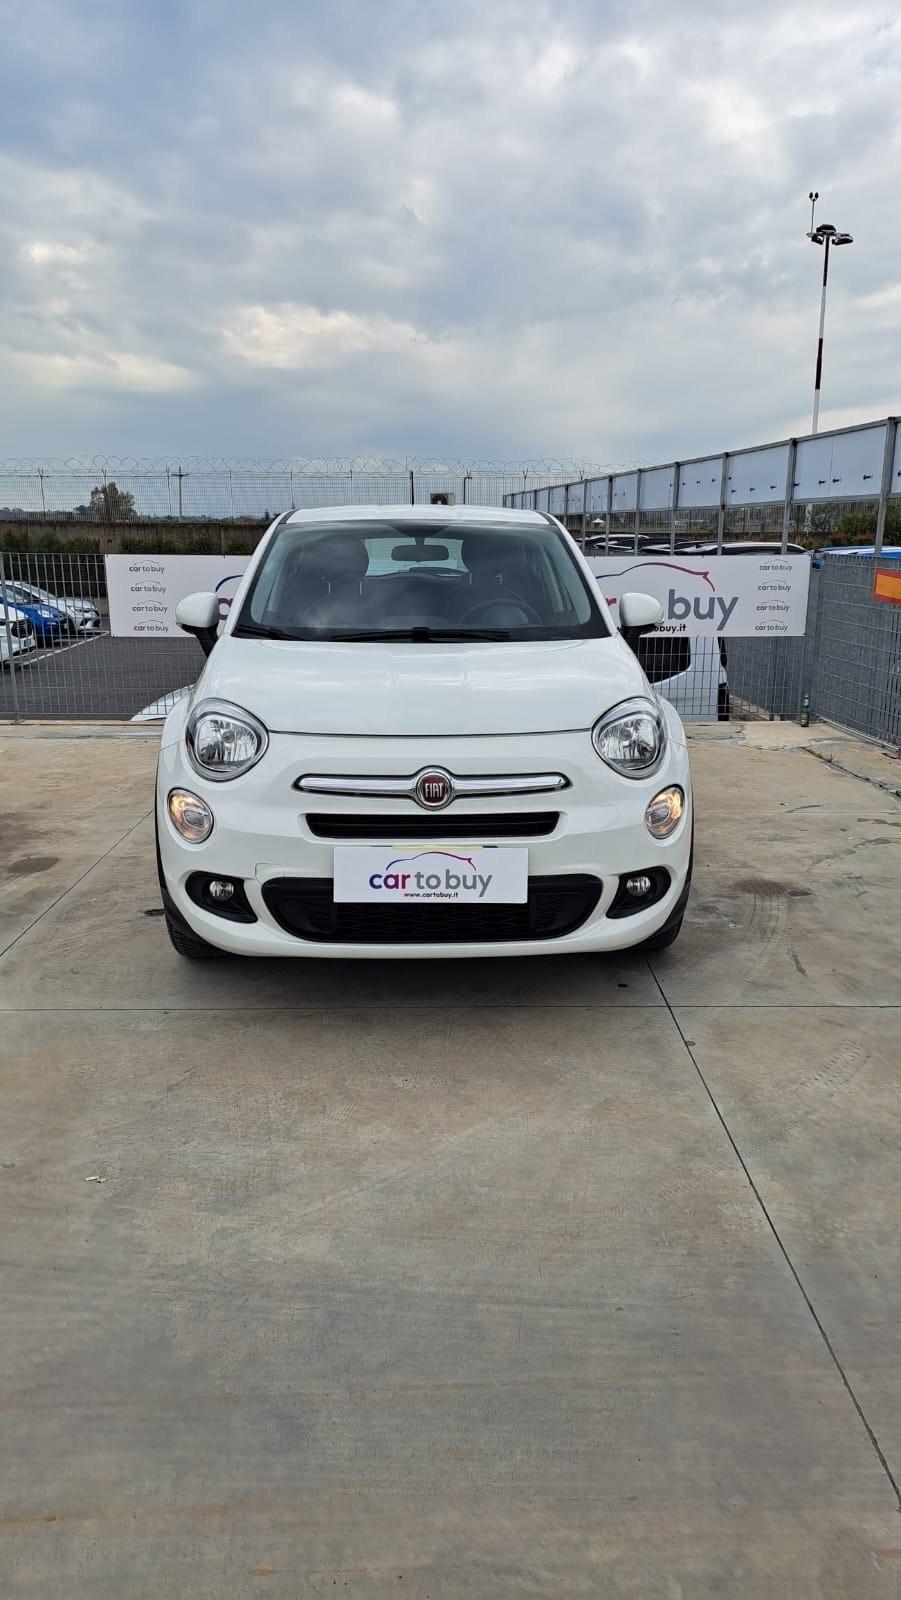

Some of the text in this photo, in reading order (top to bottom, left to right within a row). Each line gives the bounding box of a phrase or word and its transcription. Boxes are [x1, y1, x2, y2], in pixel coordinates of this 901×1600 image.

[142, 564, 150, 572] to
[151, 564, 165, 574] buy
[780, 564, 793, 572] buy
[144, 584, 152, 592] to
[152, 584, 166, 594] buy
[778, 584, 792, 592] buy
[145, 604, 153, 612] to
[154, 604, 168, 613] buy
[667, 589, 739, 631] buy
[776, 604, 790, 612] buy
[146, 624, 155, 632] to
[155, 624, 169, 633] buy
[775, 624, 788, 632] buy
[425, 782, 444, 798] FIAT
[369, 869, 493, 898] car to buy
